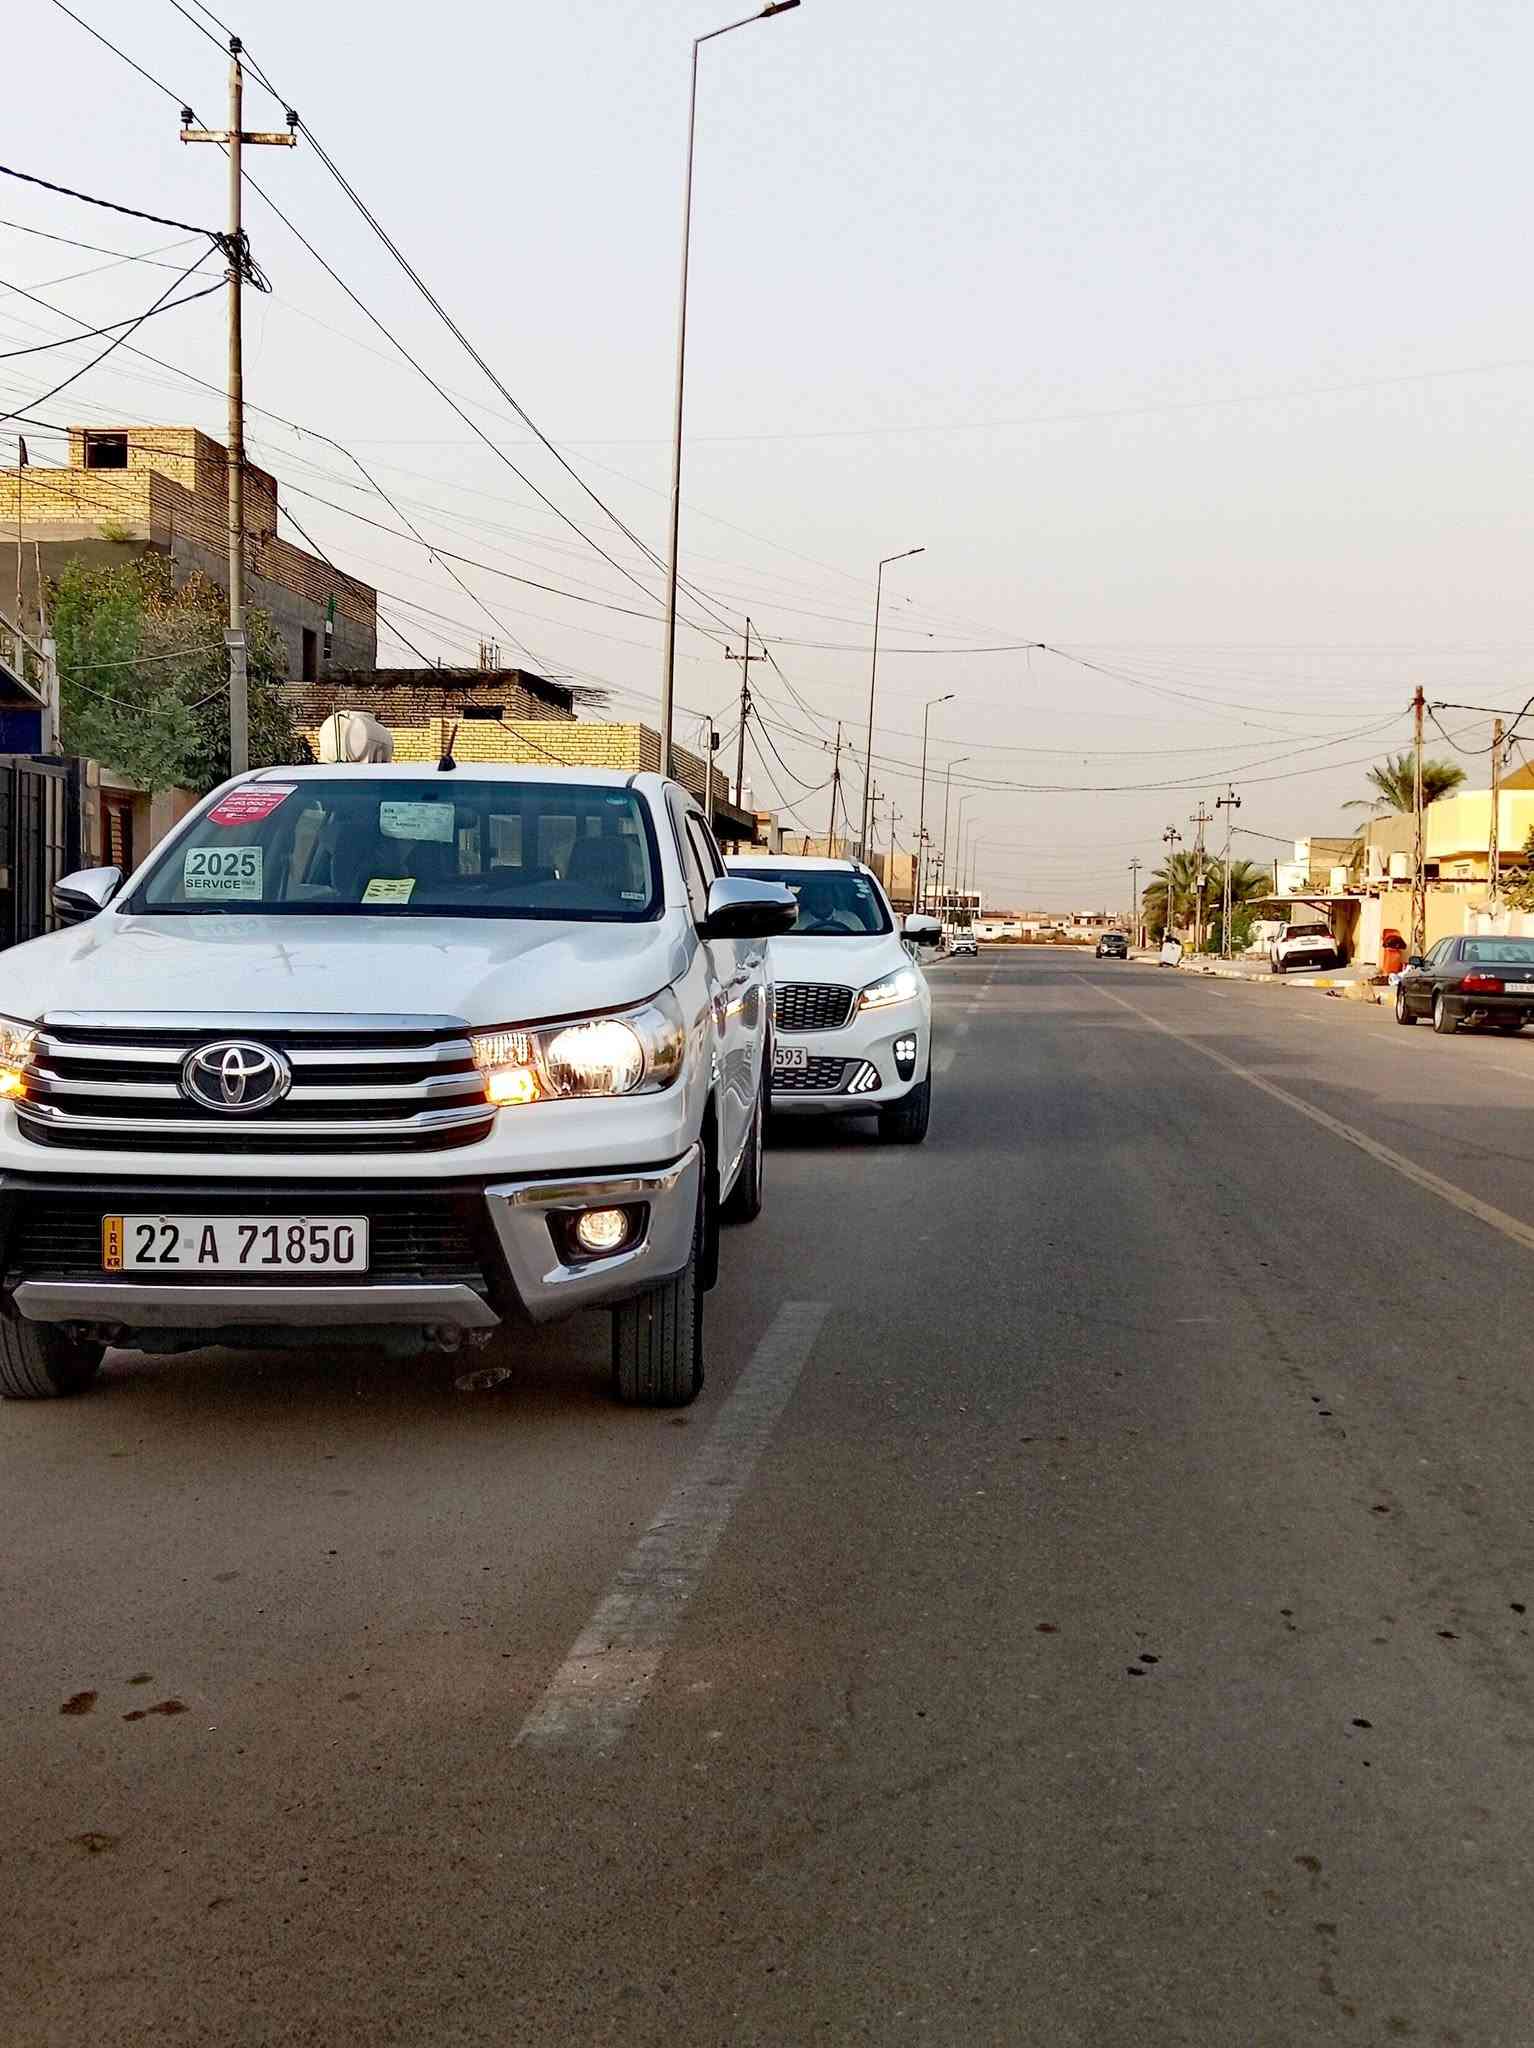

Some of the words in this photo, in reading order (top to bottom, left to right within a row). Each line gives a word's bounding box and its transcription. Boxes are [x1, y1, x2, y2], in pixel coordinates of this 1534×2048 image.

[191, 853, 256, 876] 2025
[186, 879, 241, 889] SERVICE
[135, 1224, 180, 1263] 22
[198, 1225, 219, 1263] A
[238, 1225, 354, 1264] 71850
